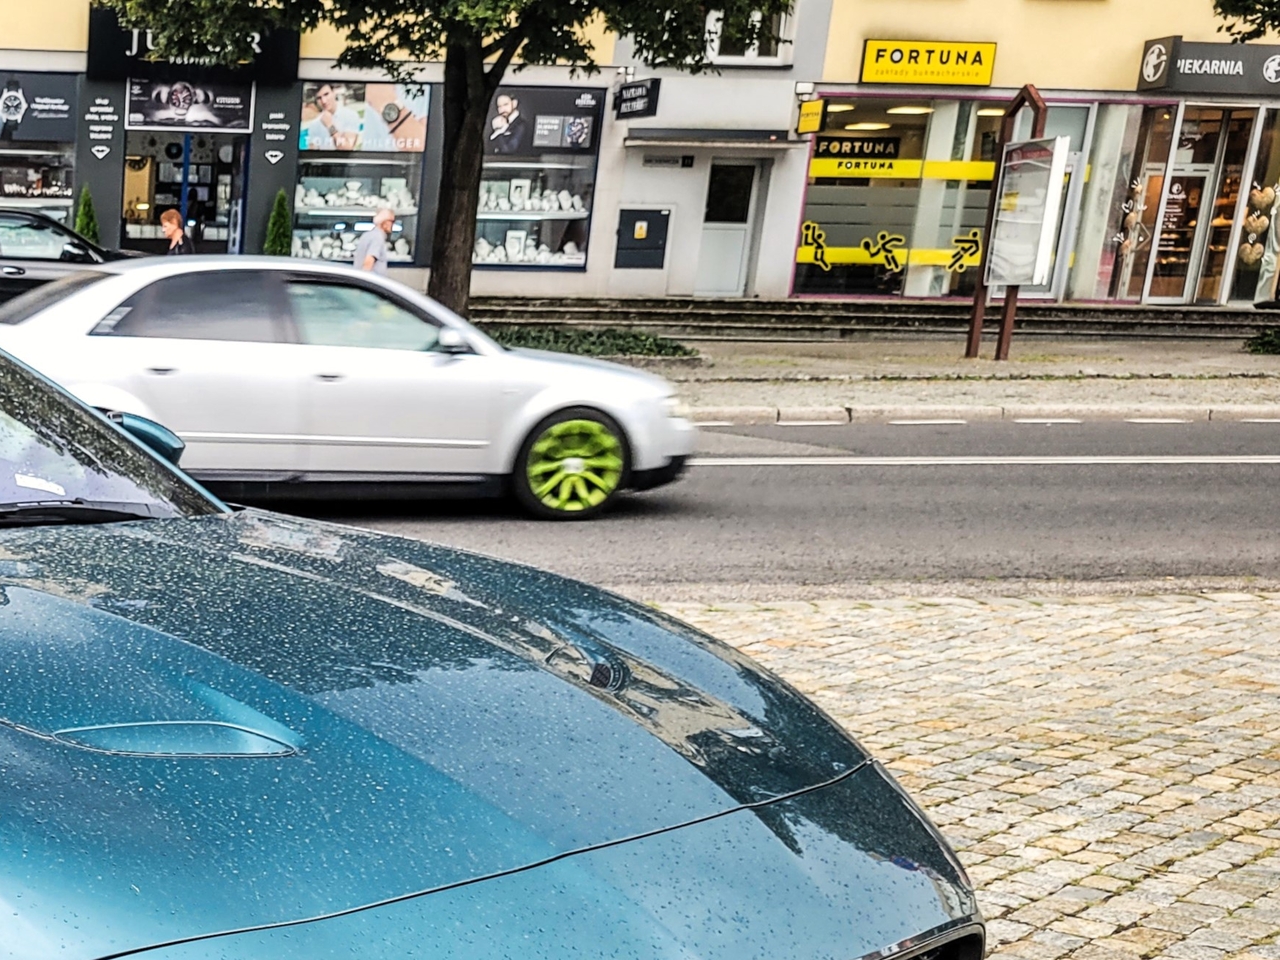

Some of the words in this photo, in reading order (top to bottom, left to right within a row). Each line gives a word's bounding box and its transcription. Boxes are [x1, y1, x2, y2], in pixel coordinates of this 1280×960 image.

[875, 48, 983, 66] FORTUNA
[818, 141, 895, 154] FORTUNA
[837, 161, 894, 170] FORTUNA
